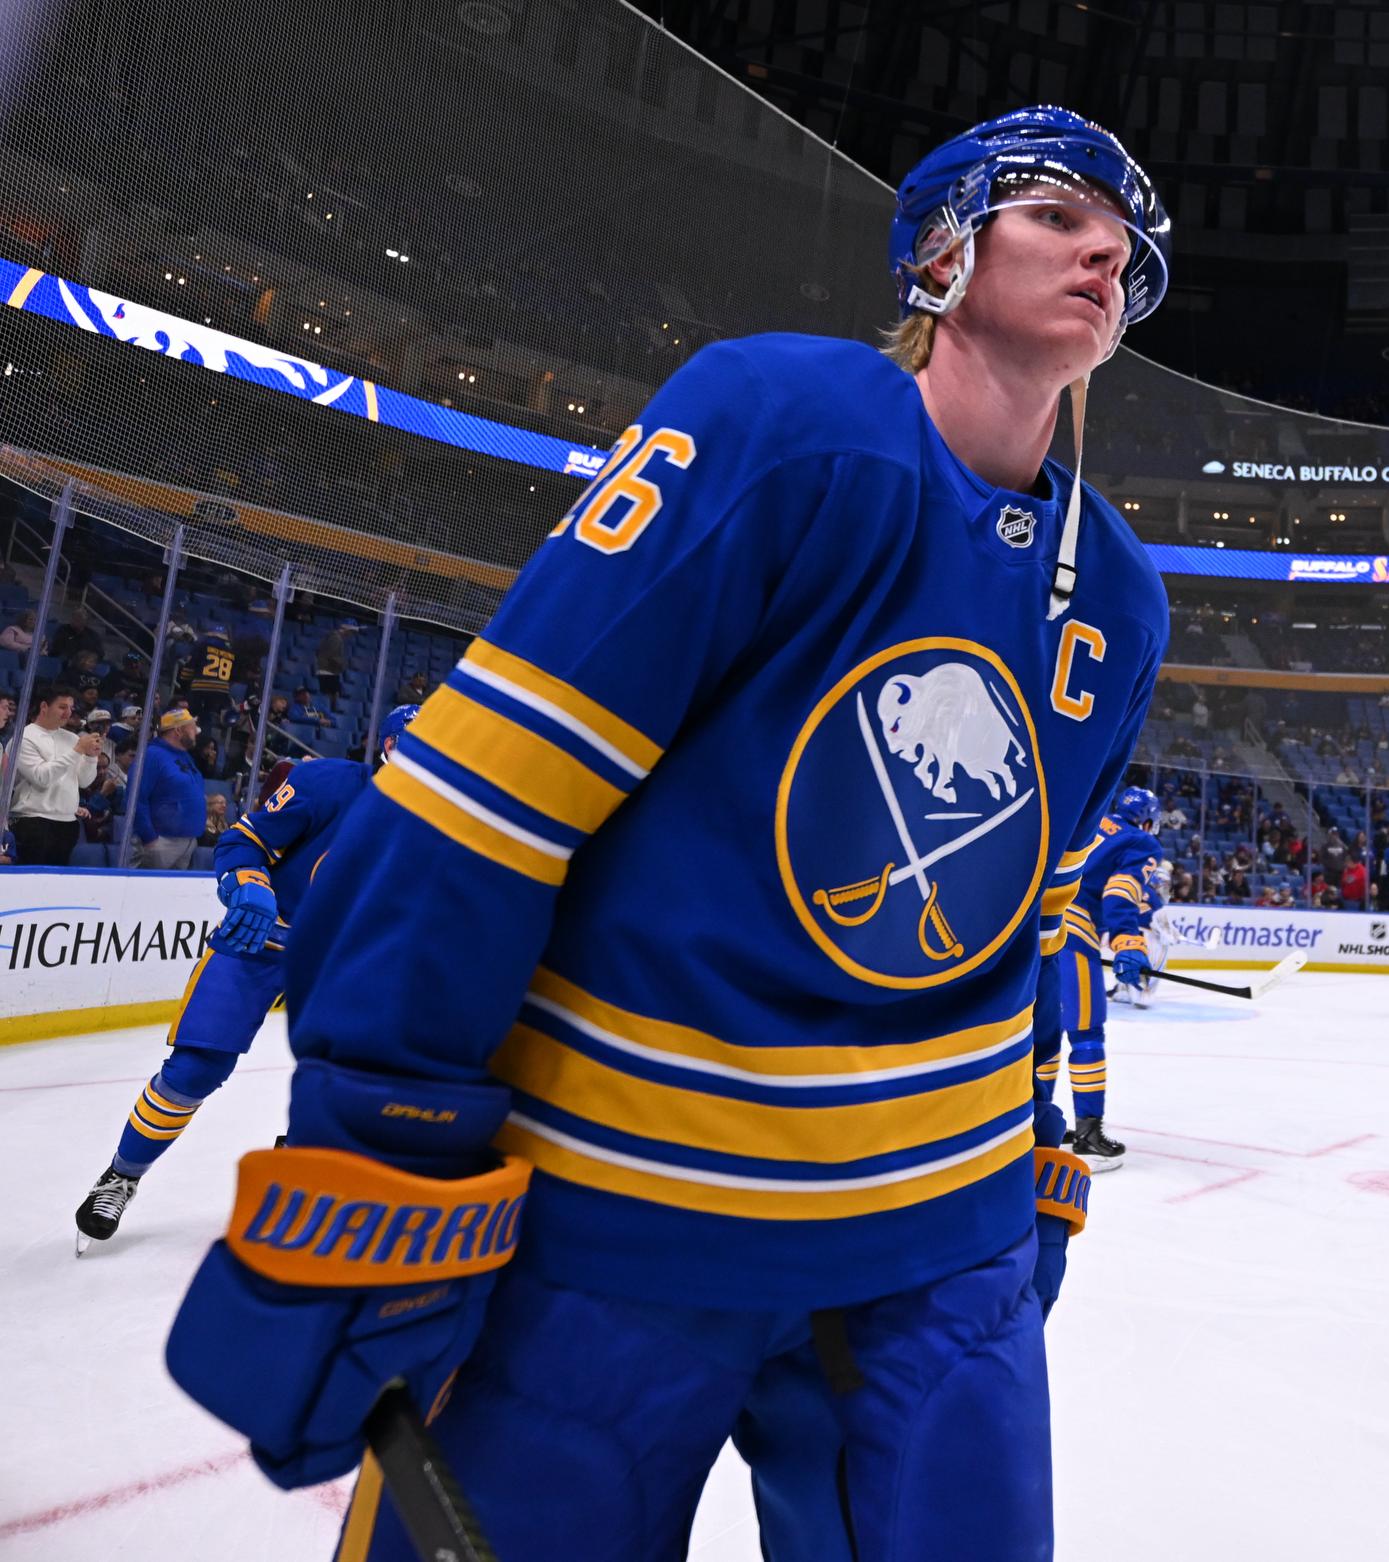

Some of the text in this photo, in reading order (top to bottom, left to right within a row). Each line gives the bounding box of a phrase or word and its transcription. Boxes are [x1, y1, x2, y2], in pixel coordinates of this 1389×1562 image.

[1232, 462, 1296, 481] SENECA
[1300, 466, 1377, 482] BUFFALO
[1004, 522, 1029, 537] NHL
[1291, 560, 1371, 573] BUFFALO
[202, 654, 233, 681] 28
[1050, 618, 1108, 722] C
